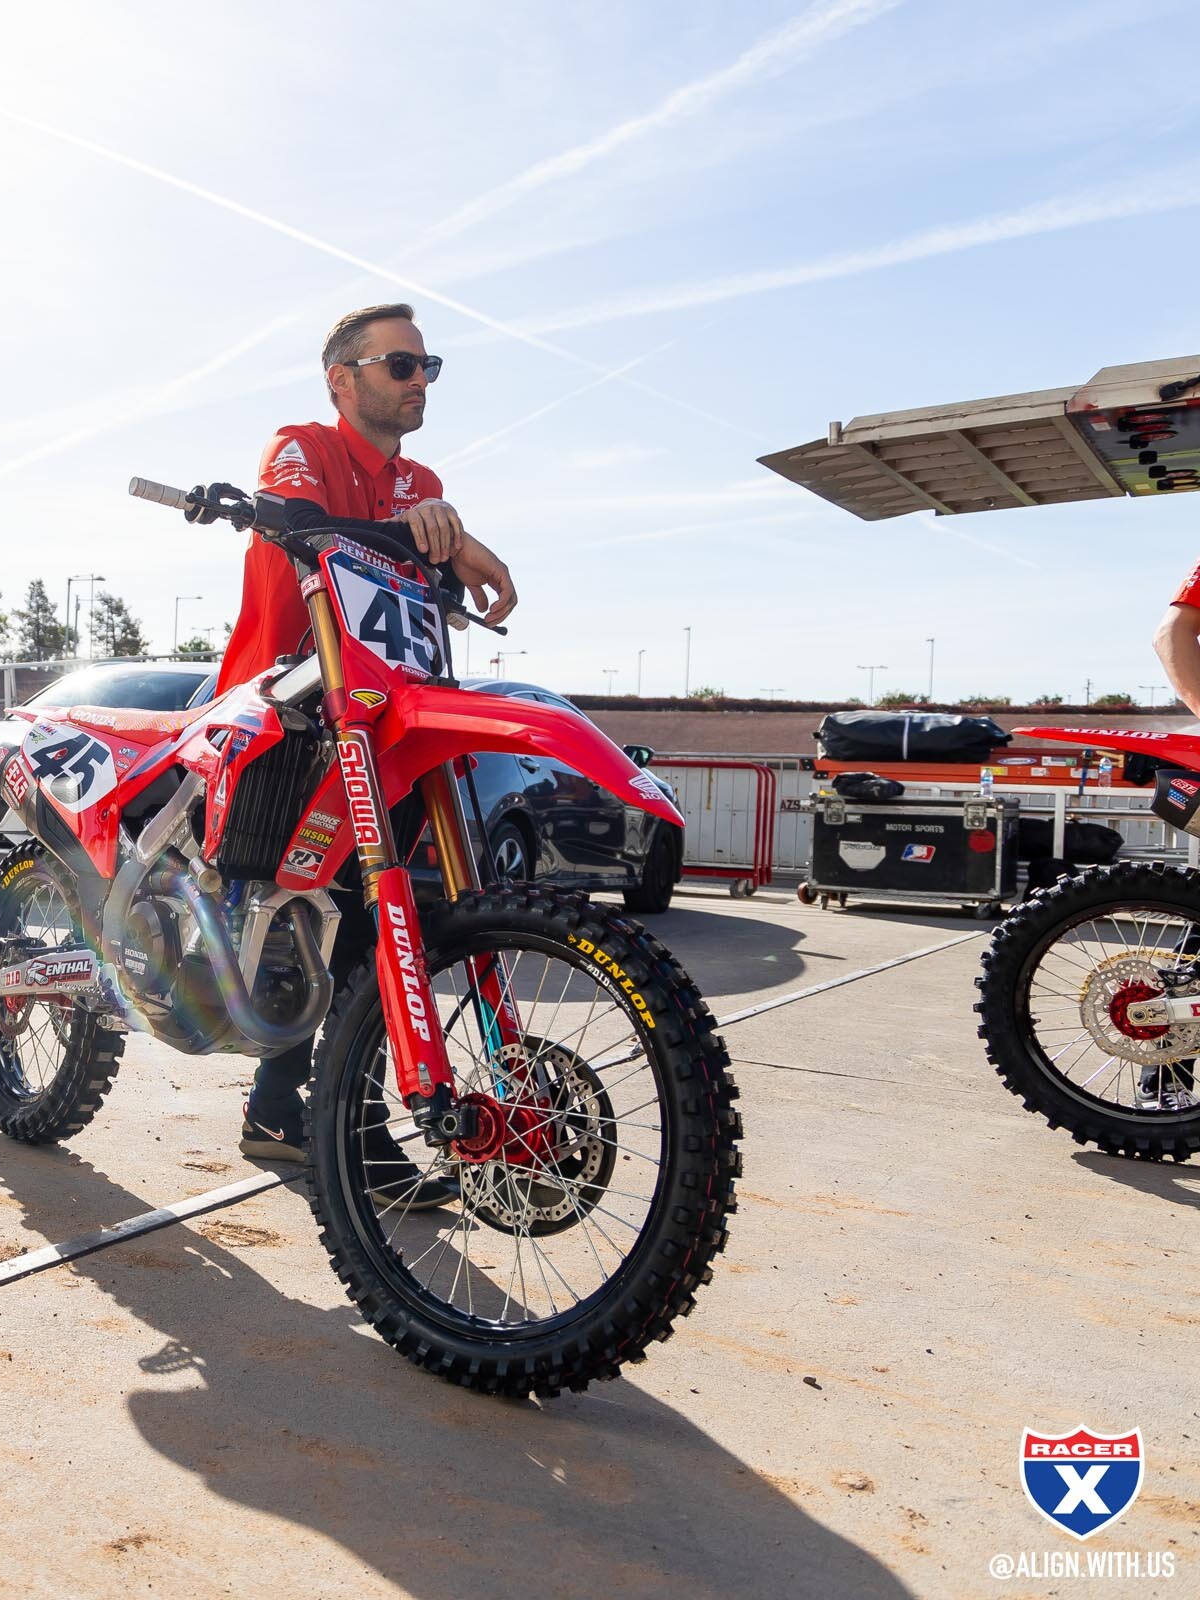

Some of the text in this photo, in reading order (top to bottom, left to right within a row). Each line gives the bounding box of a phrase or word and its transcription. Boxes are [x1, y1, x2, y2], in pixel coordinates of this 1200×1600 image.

[338, 542, 400, 576] RENTHAL
[359, 587, 446, 677] 45
[400, 664, 430, 681] HOND
[30, 733, 110, 803] 45
[337, 740, 381, 846] SHOWA
[886, 823, 945, 833] MOTOR SPORTS
[3, 860, 34, 888] DUNLOP
[125, 948, 149, 961] HONDA
[25, 960, 91, 985] RENTHAL
[387, 902, 431, 1042] DUNLOP
[576, 938, 656, 1029] DUNLOP
